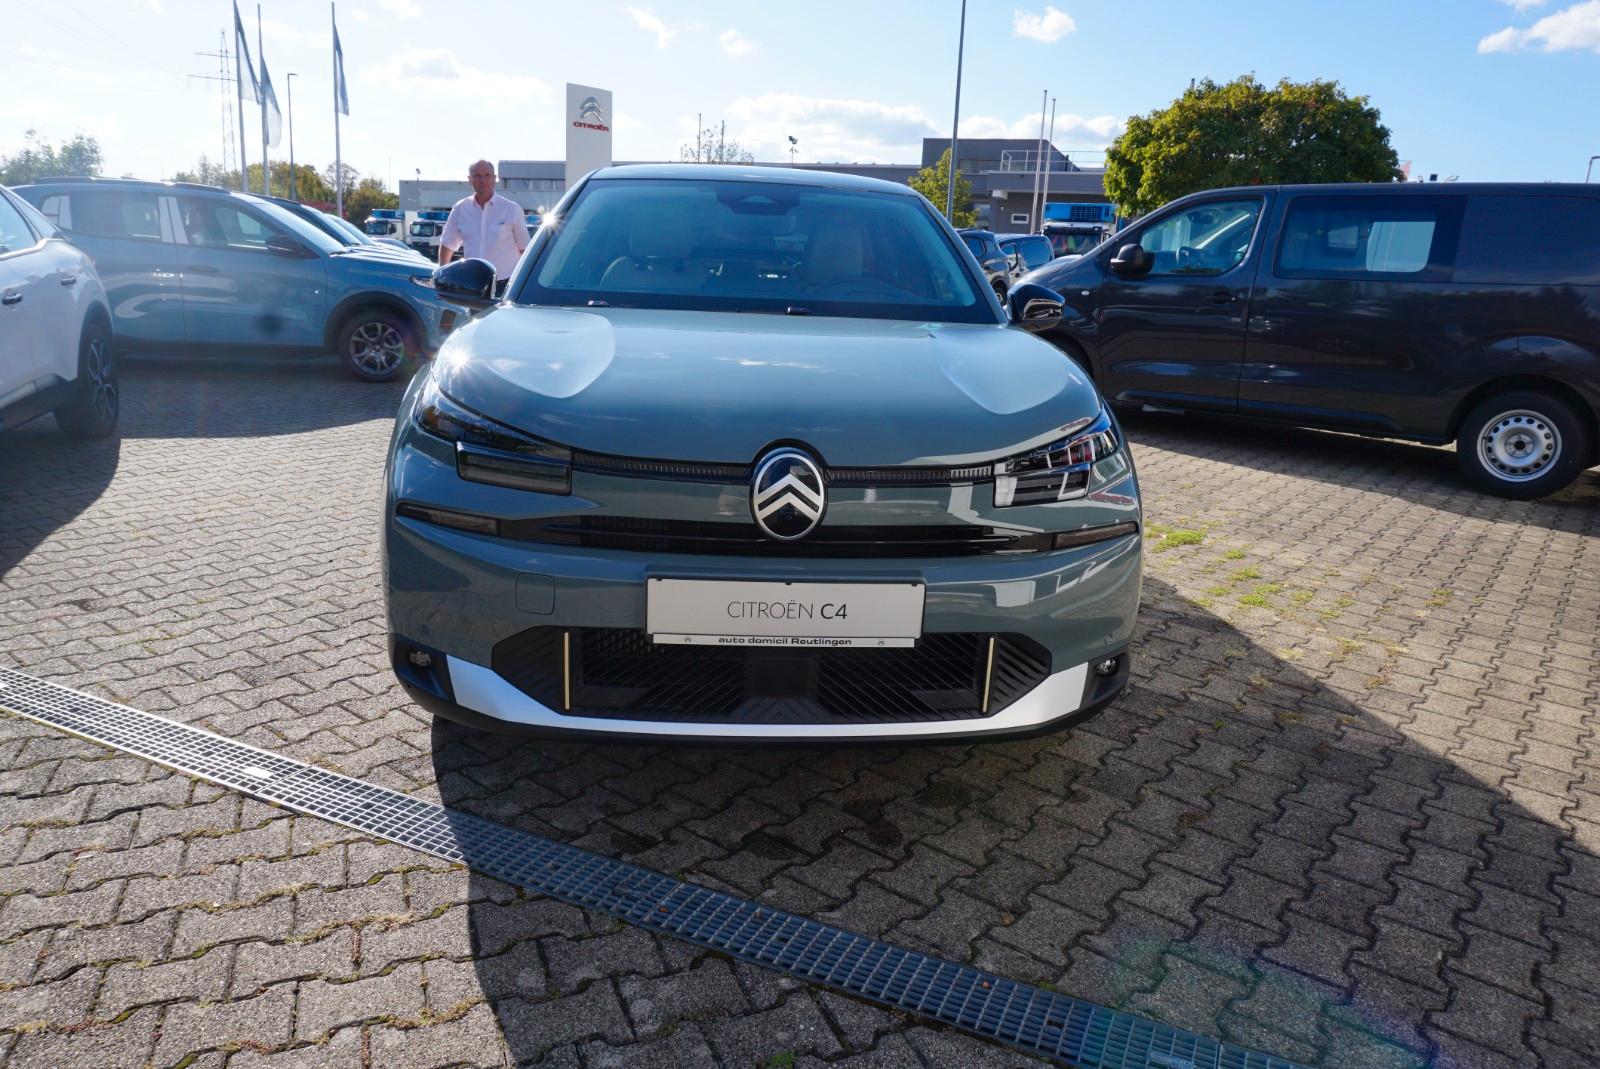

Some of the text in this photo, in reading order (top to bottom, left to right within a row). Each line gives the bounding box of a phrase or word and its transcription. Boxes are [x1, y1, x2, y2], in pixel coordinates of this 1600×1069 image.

[727, 599, 848, 620] CITROËN C4
[718, 636, 852, 647] auto domicil Reutlingen
